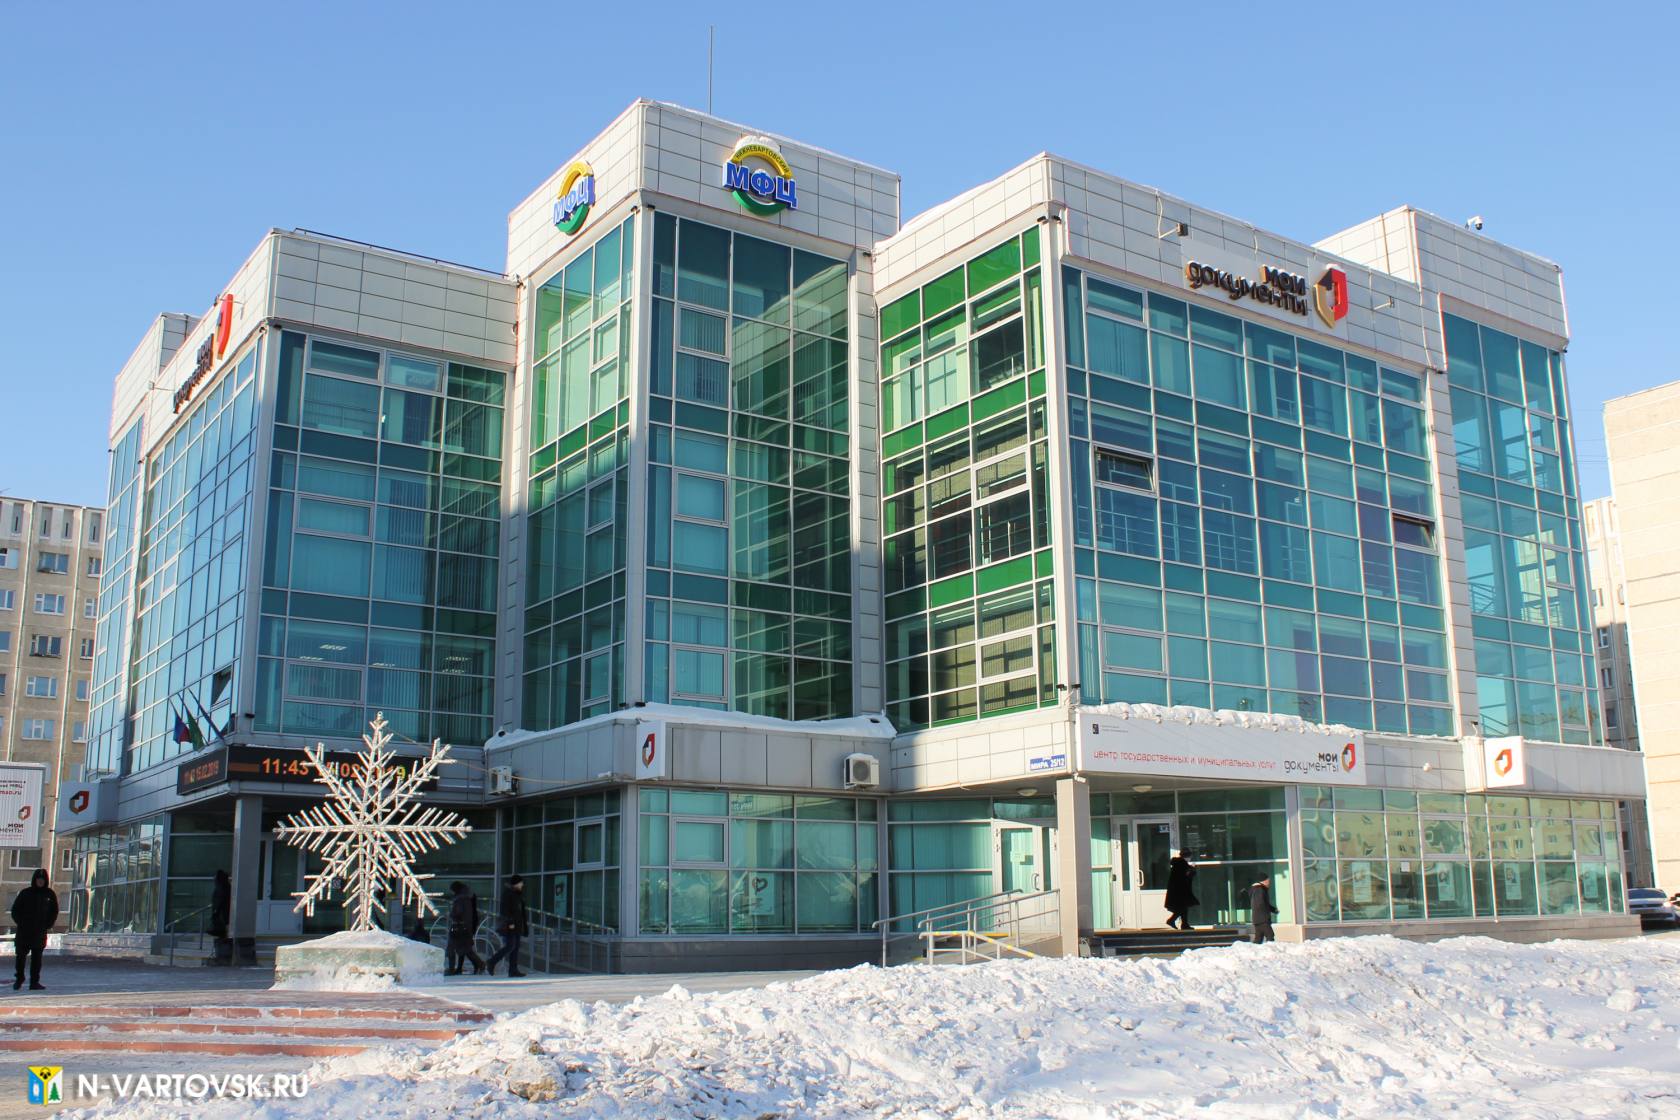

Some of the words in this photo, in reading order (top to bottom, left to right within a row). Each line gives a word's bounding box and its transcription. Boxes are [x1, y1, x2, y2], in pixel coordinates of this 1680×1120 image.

[553, 175, 593, 225] МФЦ
[726, 160, 798, 208] МФЦ
[1284, 760, 1339, 774] документы
